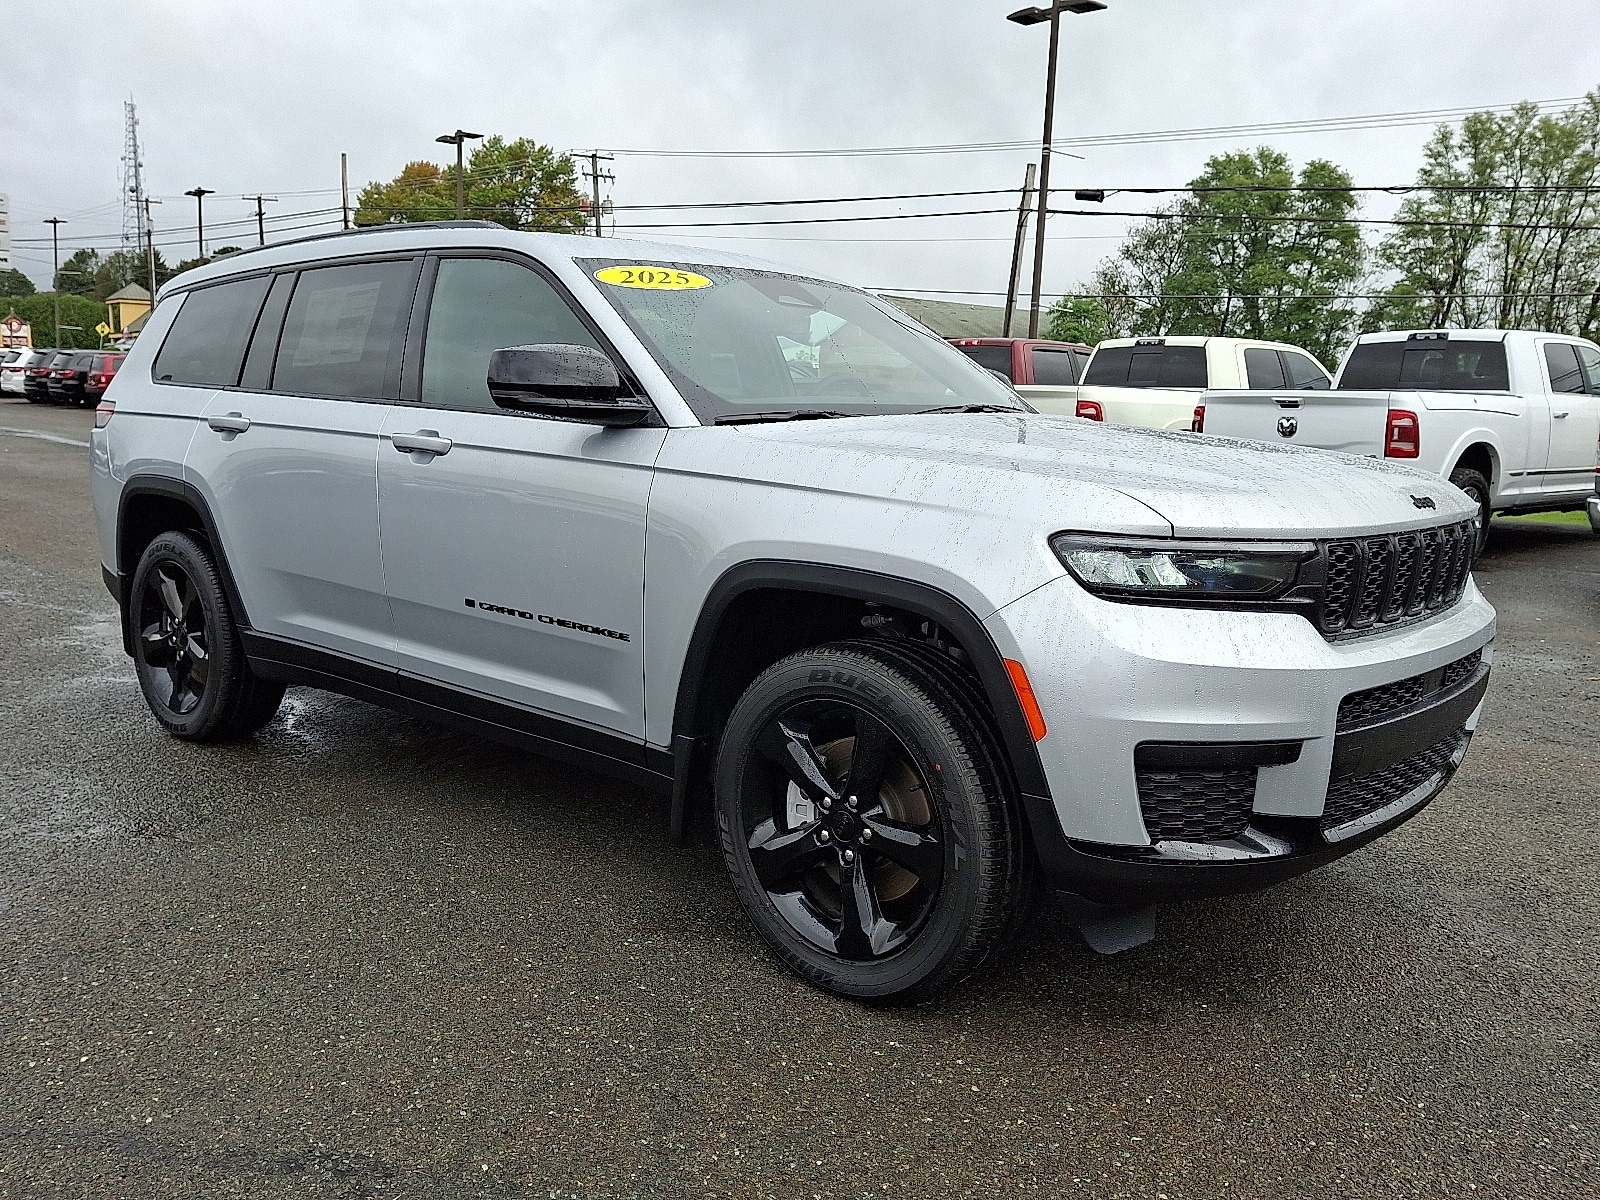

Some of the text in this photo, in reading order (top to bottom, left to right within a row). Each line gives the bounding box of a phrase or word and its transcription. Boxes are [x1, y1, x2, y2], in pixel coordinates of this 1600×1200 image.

[619, 270, 690, 285] 2025
[1409, 494, 1437, 511] Jeep
[478, 601, 631, 643] GRAND CHEROKEE
